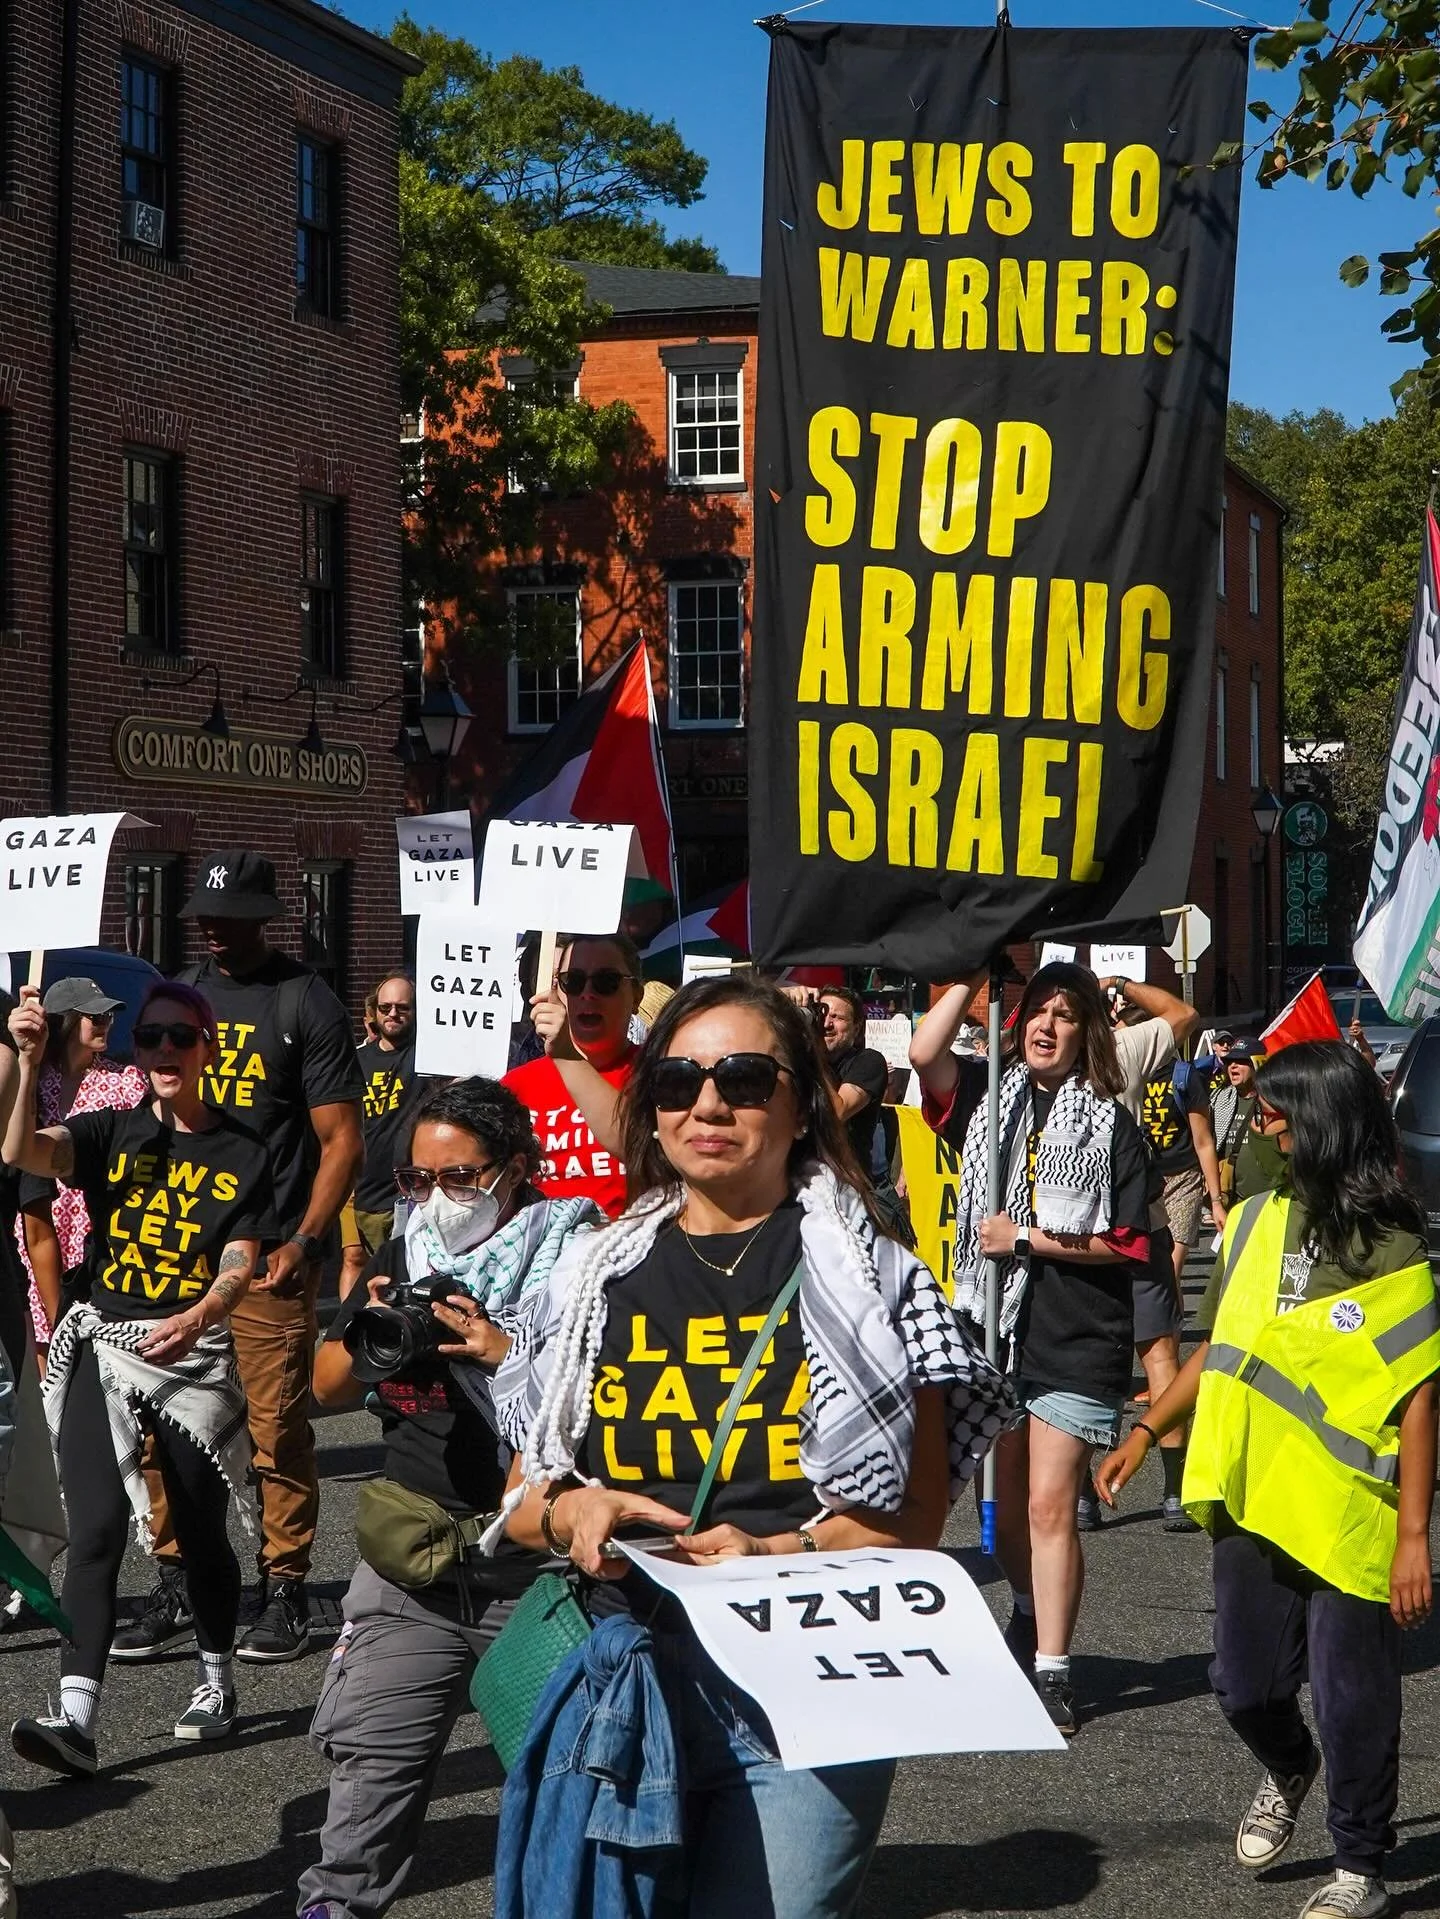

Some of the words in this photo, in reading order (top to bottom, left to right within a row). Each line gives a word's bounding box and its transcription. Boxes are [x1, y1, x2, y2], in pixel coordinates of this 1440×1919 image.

[817, 140, 1033, 236] JEWS
[1064, 142, 1160, 239] TO
[819, 247, 1177, 355] WARNER:
[805, 406, 1052, 557] STOP
[797, 564, 1171, 731] ARMING
[127, 730, 241, 774] COMFORT
[249, 742, 292, 778] ONE
[299, 750, 361, 786] SHOES
[798, 720, 1104, 882] ISRAEL
[6, 827, 96, 850] GAZA
[408, 848, 465, 862] GAZA
[417, 834, 453, 843] LET
[512, 843, 600, 871] LIVE
[9, 863, 83, 891] LIVE
[414, 869, 460, 883] LIVE
[445, 943, 491, 964] LET
[1102, 951, 1135, 962] LIVE
[431, 975, 503, 999] GAZA
[435, 1007, 495, 1030] LIVE
[217, 1023, 256, 1049] ET
[198, 1076, 254, 1107] IVE
[365, 1092, 399, 1117] IVE
[1143, 1107, 1169, 1123] ET
[108, 1153, 239, 1202] JEWS
[125, 1185, 201, 1219] SAY
[110, 1209, 201, 1252] LET
[110, 1243, 212, 1280] AZA
[103, 1263, 203, 1300] LIVE
[627, 1310, 789, 1364] LET
[603, 1424, 805, 1481] LIVE
[727, 1580, 946, 1633] GAZA
[815, 1648, 951, 1681] LET
